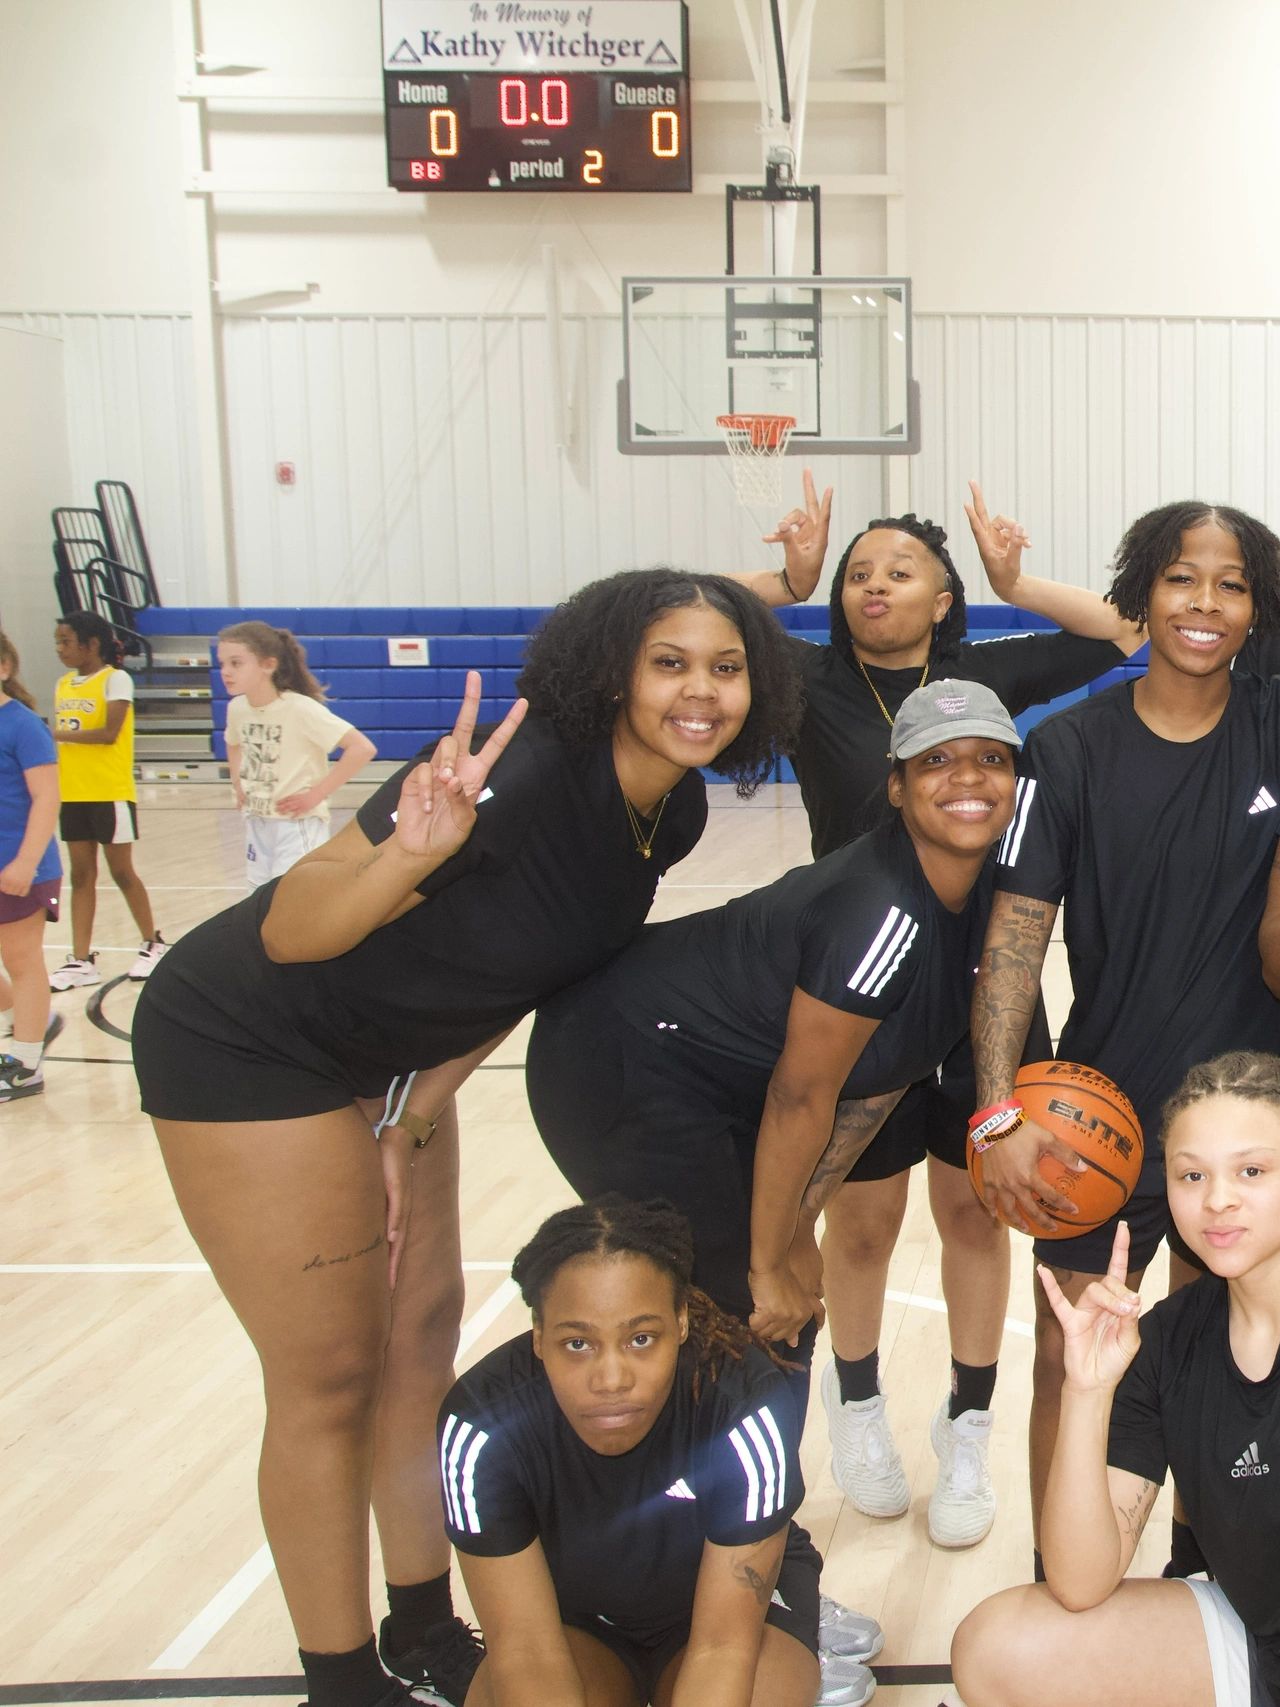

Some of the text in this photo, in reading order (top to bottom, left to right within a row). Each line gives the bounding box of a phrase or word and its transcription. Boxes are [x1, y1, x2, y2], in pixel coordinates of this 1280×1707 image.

[470, 2, 593, 27] In Memory of
[420, 29, 645, 66] Kathy Witchger
[398, 80, 448, 103] Home
[500, 79, 569, 126] 0.0
[614, 82, 676, 105] Guests
[429, 109, 458, 156] 0
[651, 110, 679, 157] 0
[510, 157, 564, 182] period
[583, 149, 603, 184] 2
[1047, 1098, 1134, 1161] ELITE
[1097, 1138, 1119, 1158] BALL
[1231, 1464, 1270, 1478] adidas
